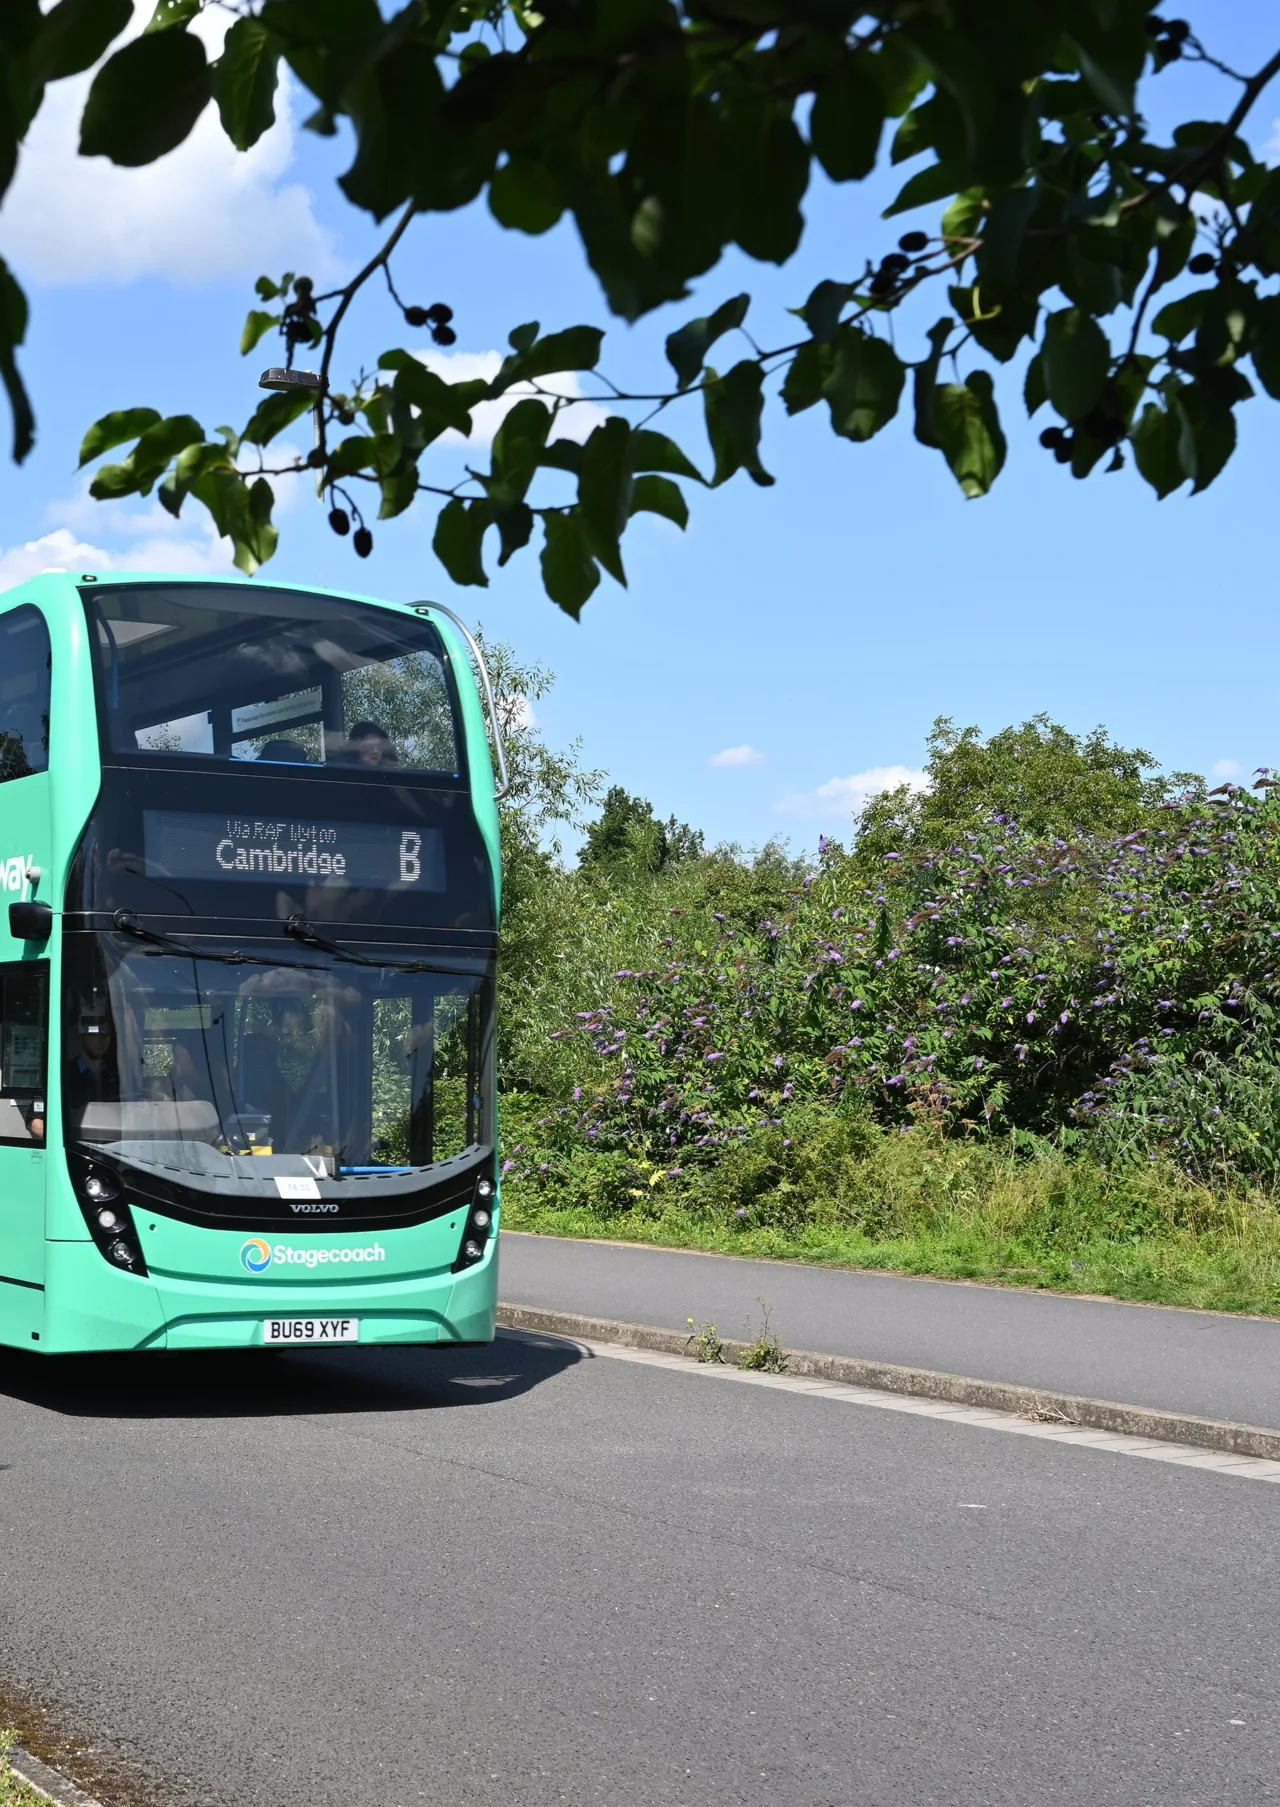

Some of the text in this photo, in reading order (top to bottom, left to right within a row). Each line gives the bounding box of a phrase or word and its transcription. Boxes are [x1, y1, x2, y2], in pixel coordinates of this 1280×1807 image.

[227, 820, 337, 843] Via RAF Wyton
[216, 839, 346, 875] Cambridge
[400, 831, 422, 882] B
[289, 1204, 339, 1213] VOLVO
[273, 1242, 386, 1268] Stagecoach
[270, 1320, 350, 1339] BU69 XYF
